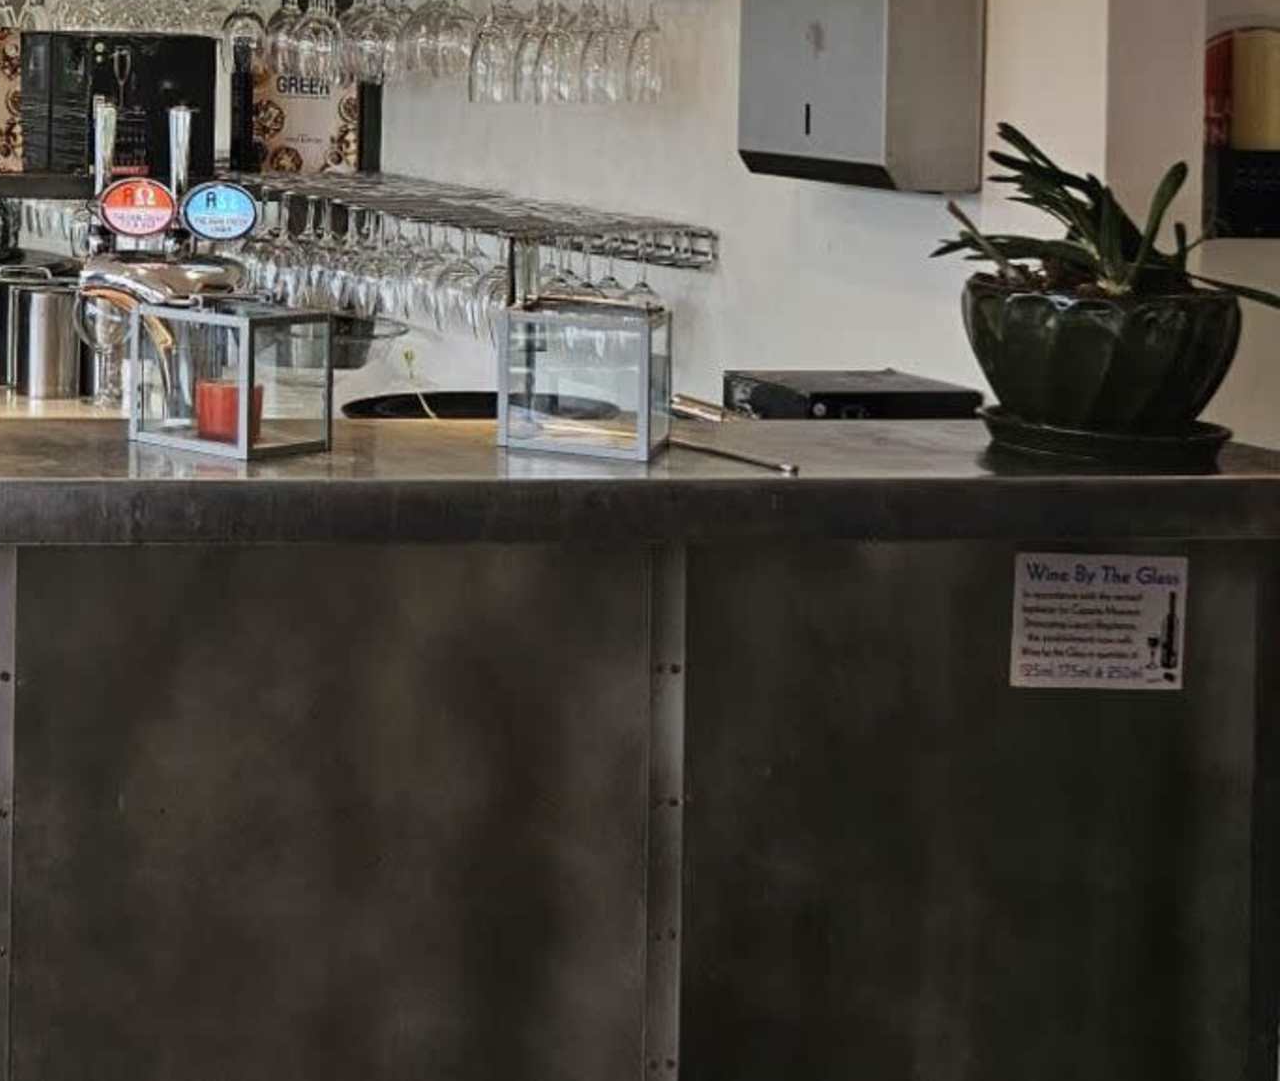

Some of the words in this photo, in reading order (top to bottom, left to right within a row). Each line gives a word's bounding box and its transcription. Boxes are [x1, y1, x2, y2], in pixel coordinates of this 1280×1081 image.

[1026, 562, 1071, 583] Wine
[1074, 564, 1096, 585] By
[1102, 565, 1131, 584] The
[1135, 566, 1180, 586] Glass
